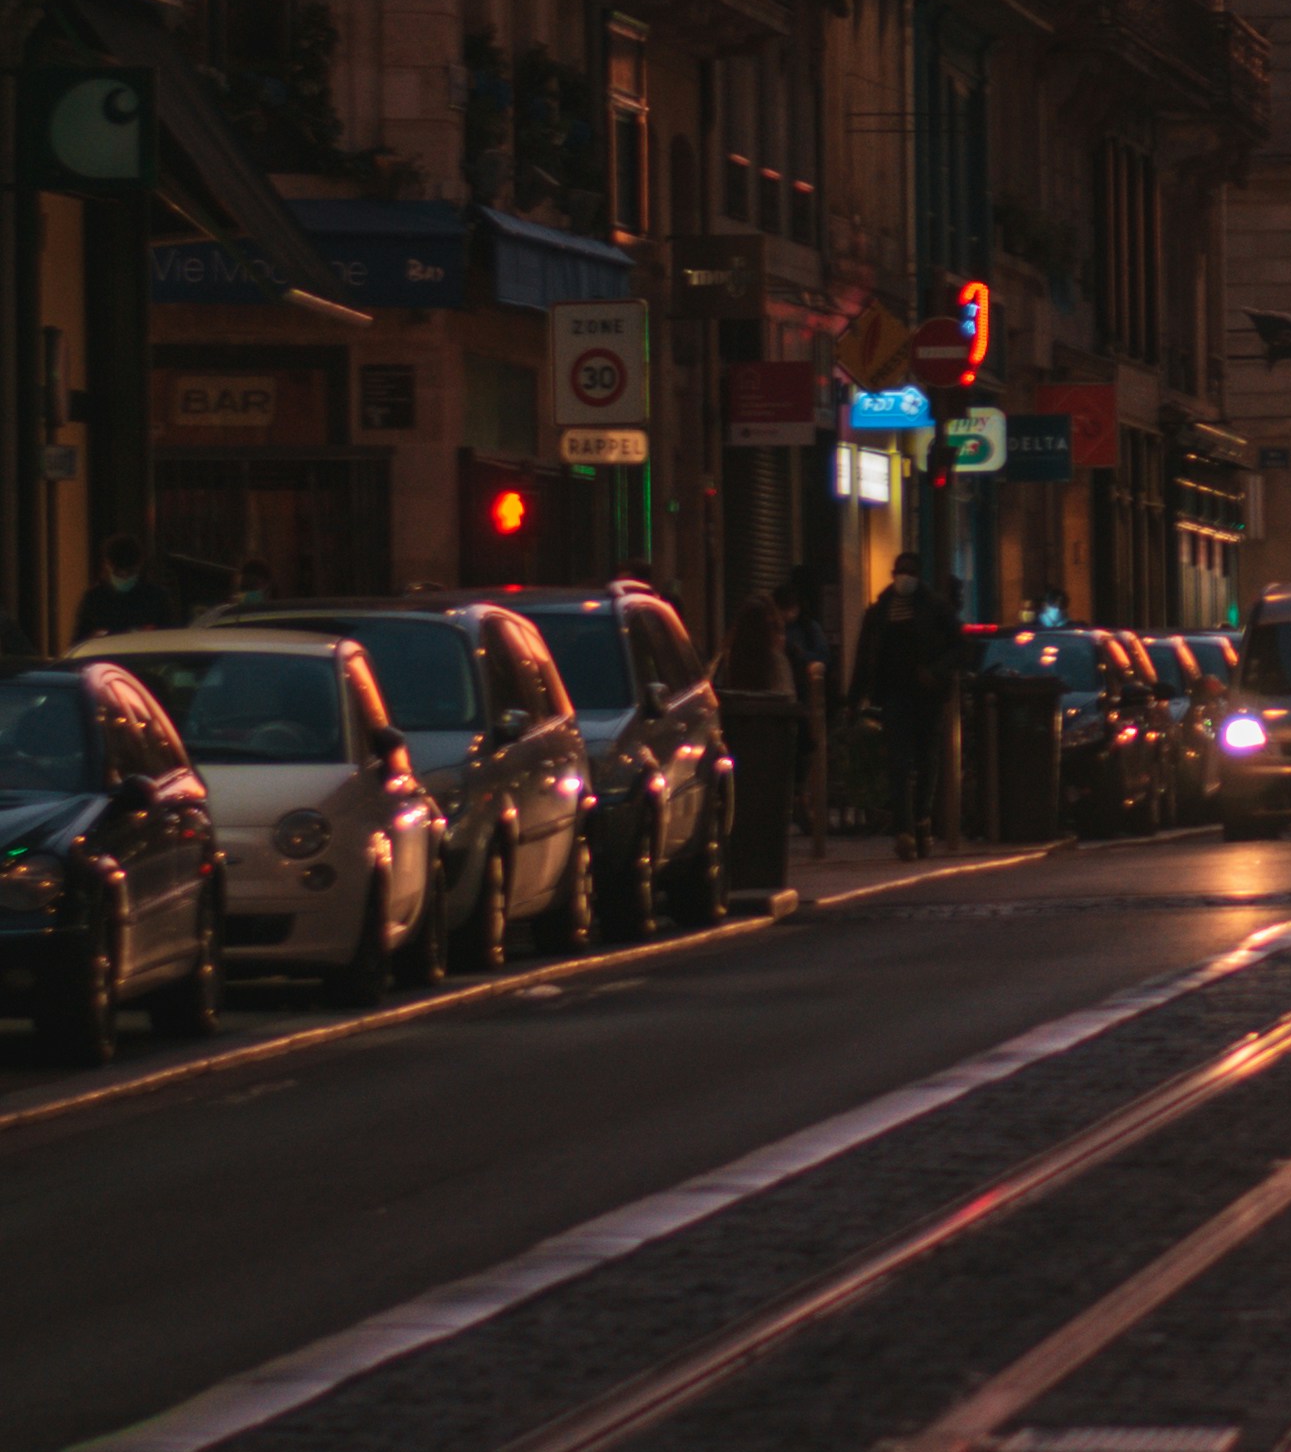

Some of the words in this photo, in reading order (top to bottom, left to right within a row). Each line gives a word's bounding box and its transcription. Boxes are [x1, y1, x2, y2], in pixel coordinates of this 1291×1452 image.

[148, 248, 205, 284] Vie
[572, 318, 625, 335] ZONE
[582, 366, 617, 390] 30
[180, 388, 270, 415] BAR
[568, 437, 643, 456] RAPPEL
[1007, 436, 1069, 452] DELTA
